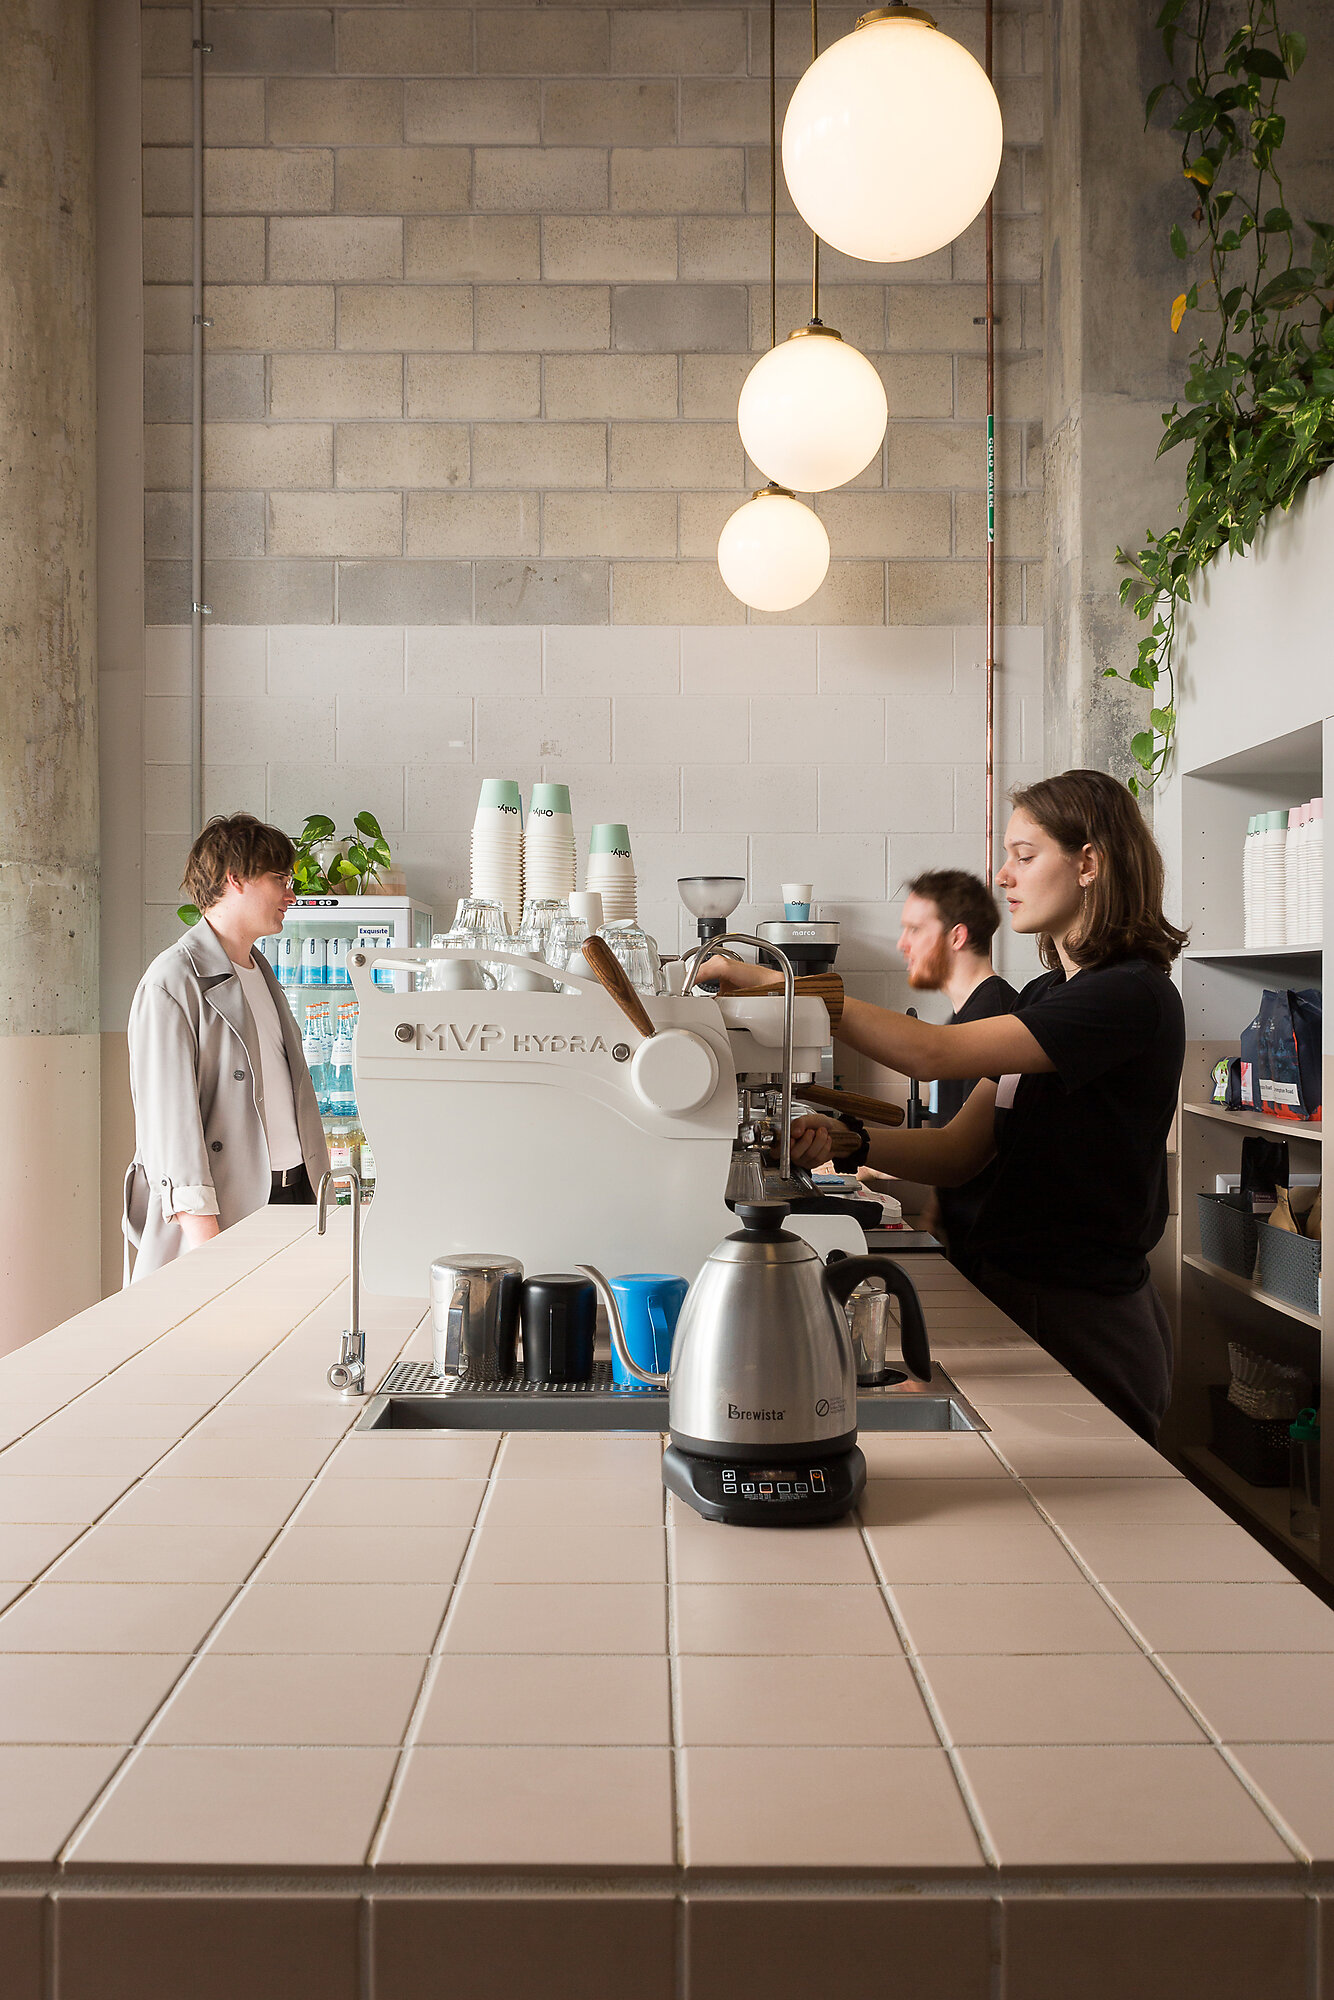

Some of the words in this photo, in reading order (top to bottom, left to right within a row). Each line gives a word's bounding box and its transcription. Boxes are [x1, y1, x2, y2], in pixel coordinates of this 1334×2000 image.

[359, 927, 388, 936] Exquisite
[415, 1023, 506, 1051] MVP
[513, 1034, 608, 1053] HYDRA
[728, 1403, 785, 1420] Brewista
